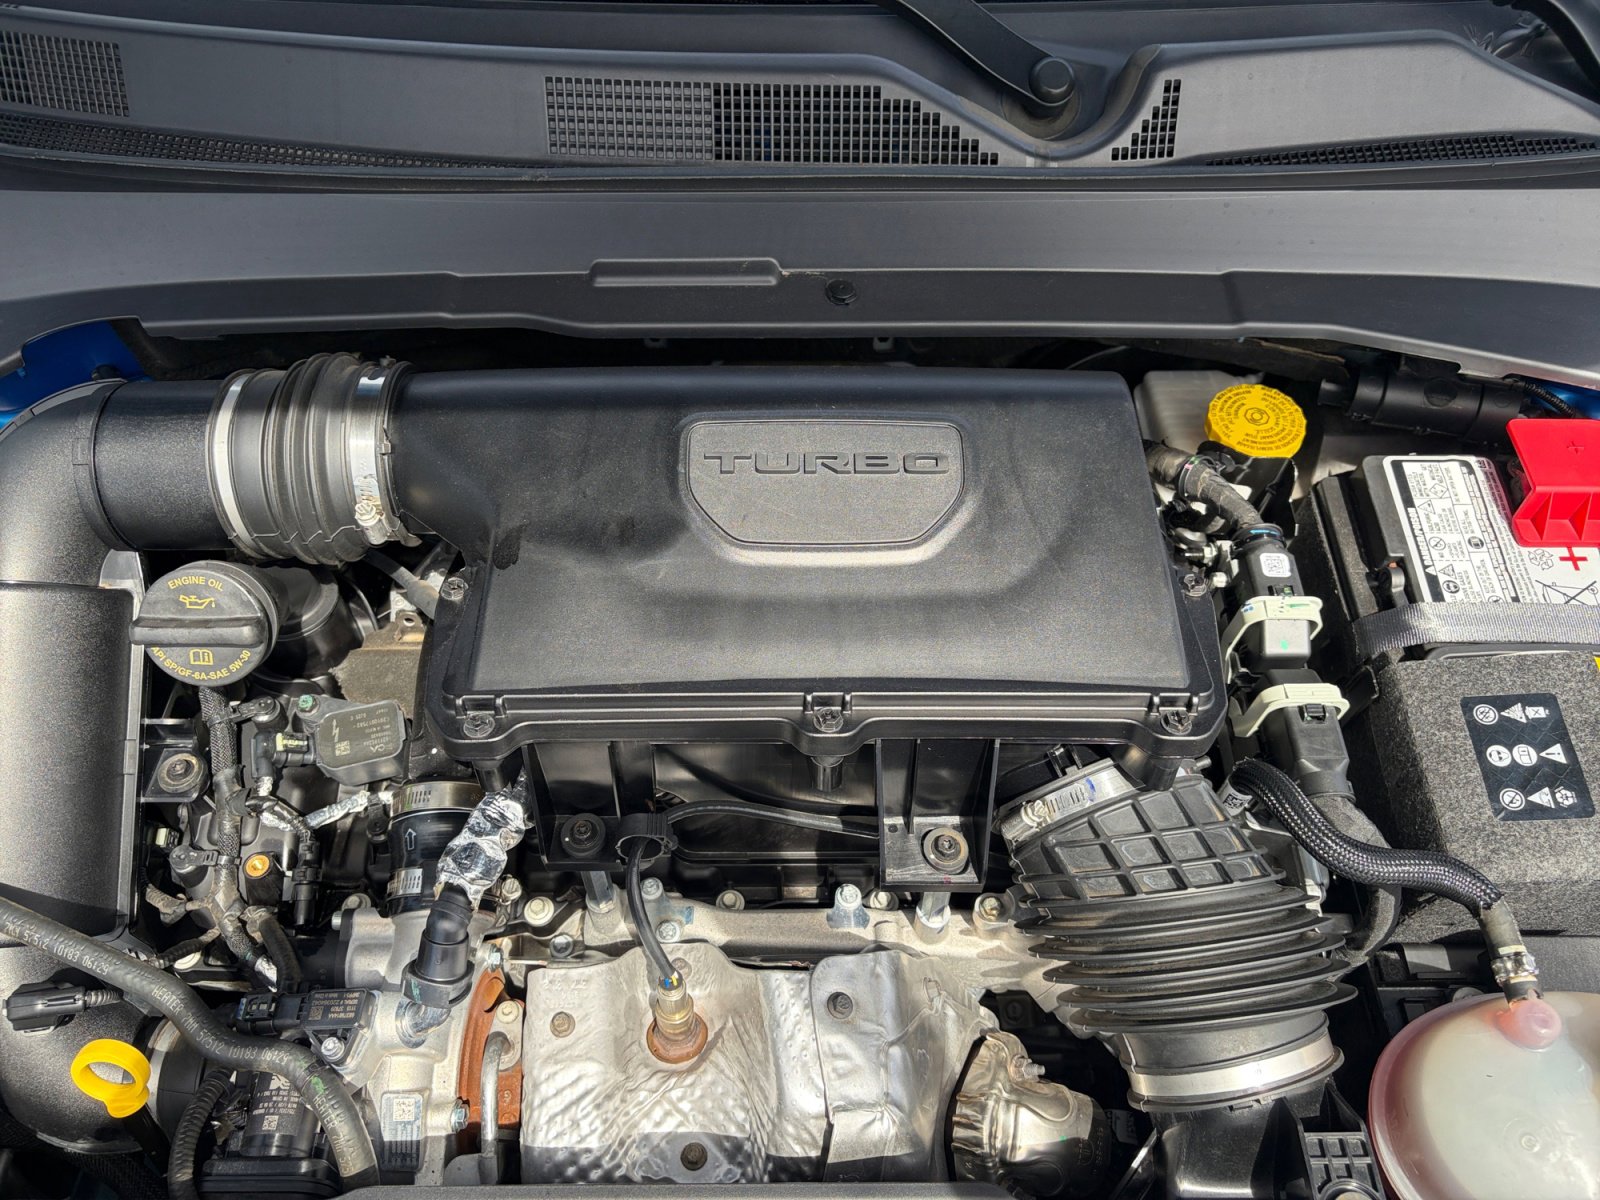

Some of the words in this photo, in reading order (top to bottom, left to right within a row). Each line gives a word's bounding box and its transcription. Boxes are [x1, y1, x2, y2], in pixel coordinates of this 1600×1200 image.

[704, 452, 950, 475] TURBO
[1406, 507, 1433, 565] DANGER/POISON
[168, 576, 206, 590] ENGINE
[208, 578, 224, 591] OIL
[163, 658, 230, 680] SP/GF-6A-SAE
[230, 650, 252, 672] 5W-30
[54, 944, 80, 962] 10183
[152, 986, 184, 1015] HEATER
[228, 1046, 258, 1059] 10183
[312, 1094, 338, 1130] HEATER
